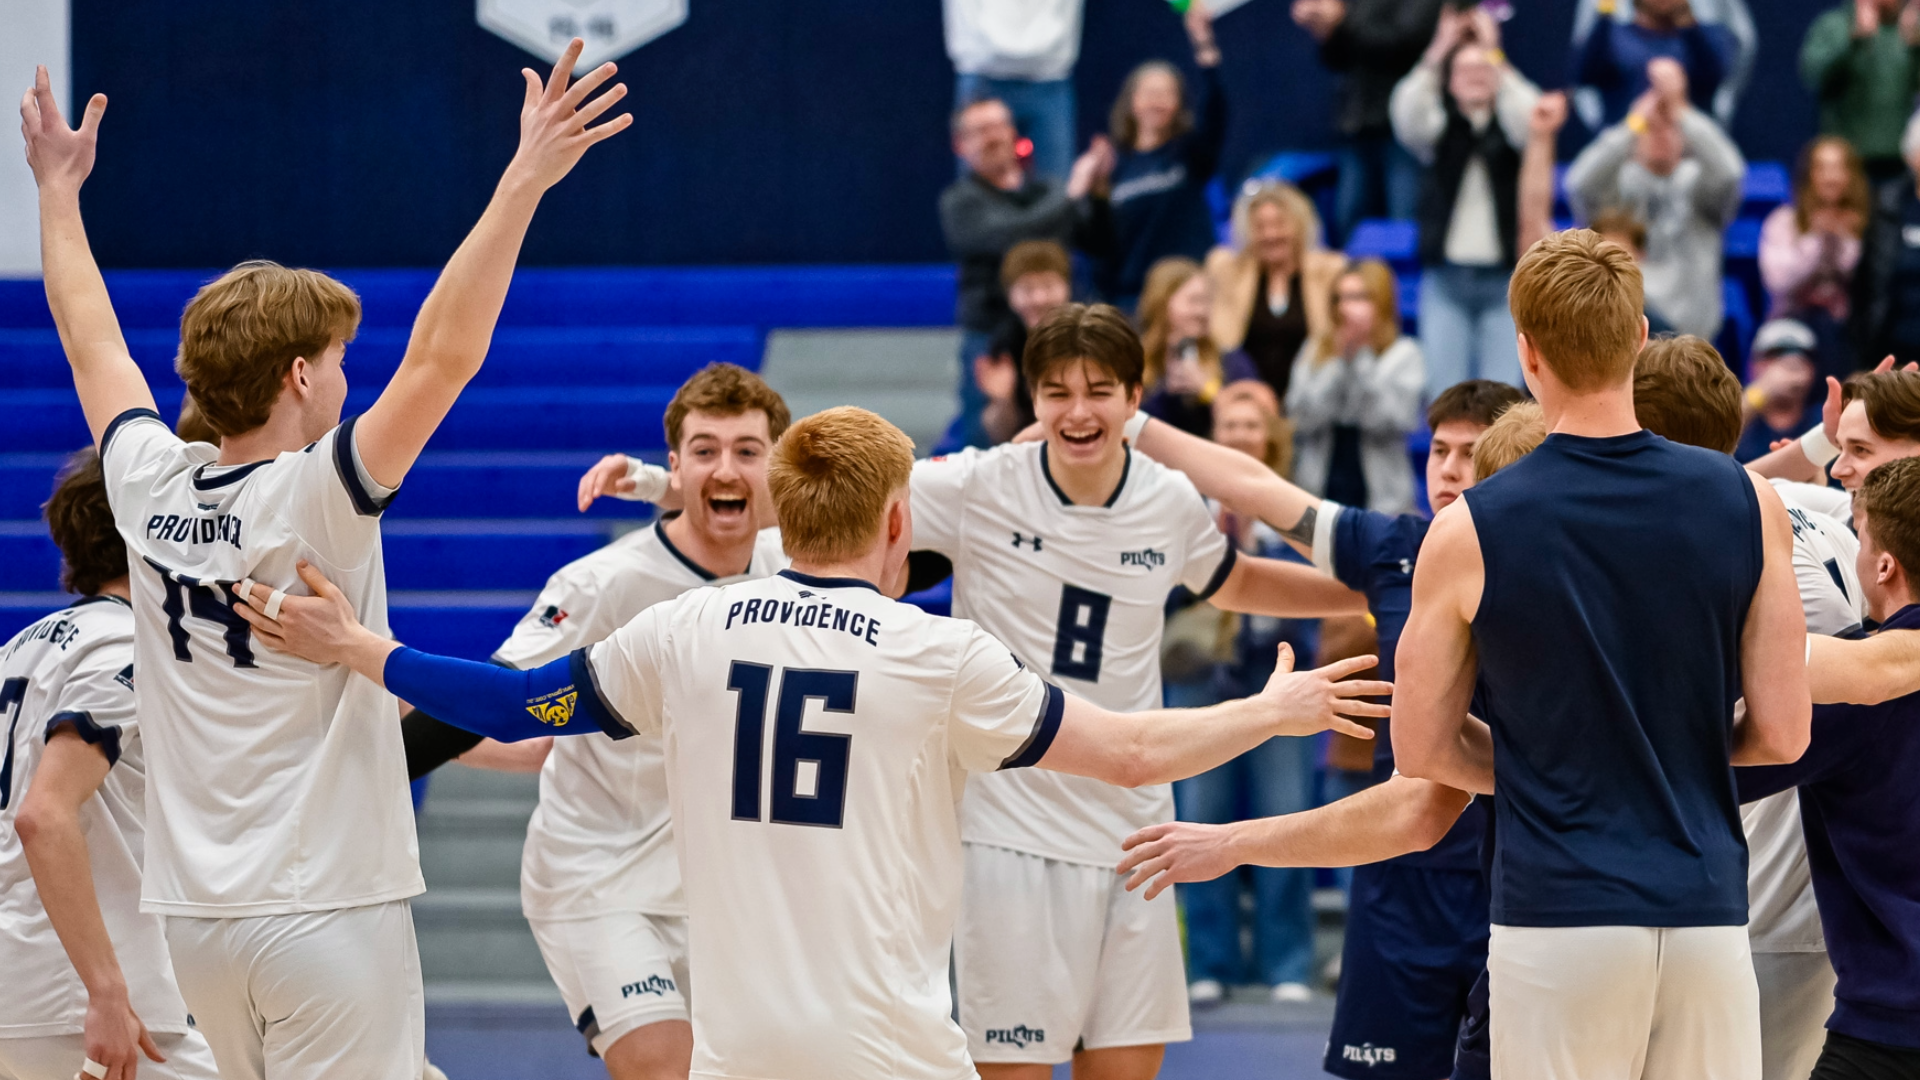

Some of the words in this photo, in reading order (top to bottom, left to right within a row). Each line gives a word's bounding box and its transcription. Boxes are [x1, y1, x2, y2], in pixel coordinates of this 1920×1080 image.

[1121, 548, 1165, 571] PILOTS
[143, 555, 259, 668] 14
[725, 598, 881, 647] PROVIDENCE
[1050, 583, 1112, 683] 8
[727, 660, 859, 829] 16
[986, 1024, 1045, 1049] PILOTS
[1343, 1043, 1396, 1067] PILOTS
